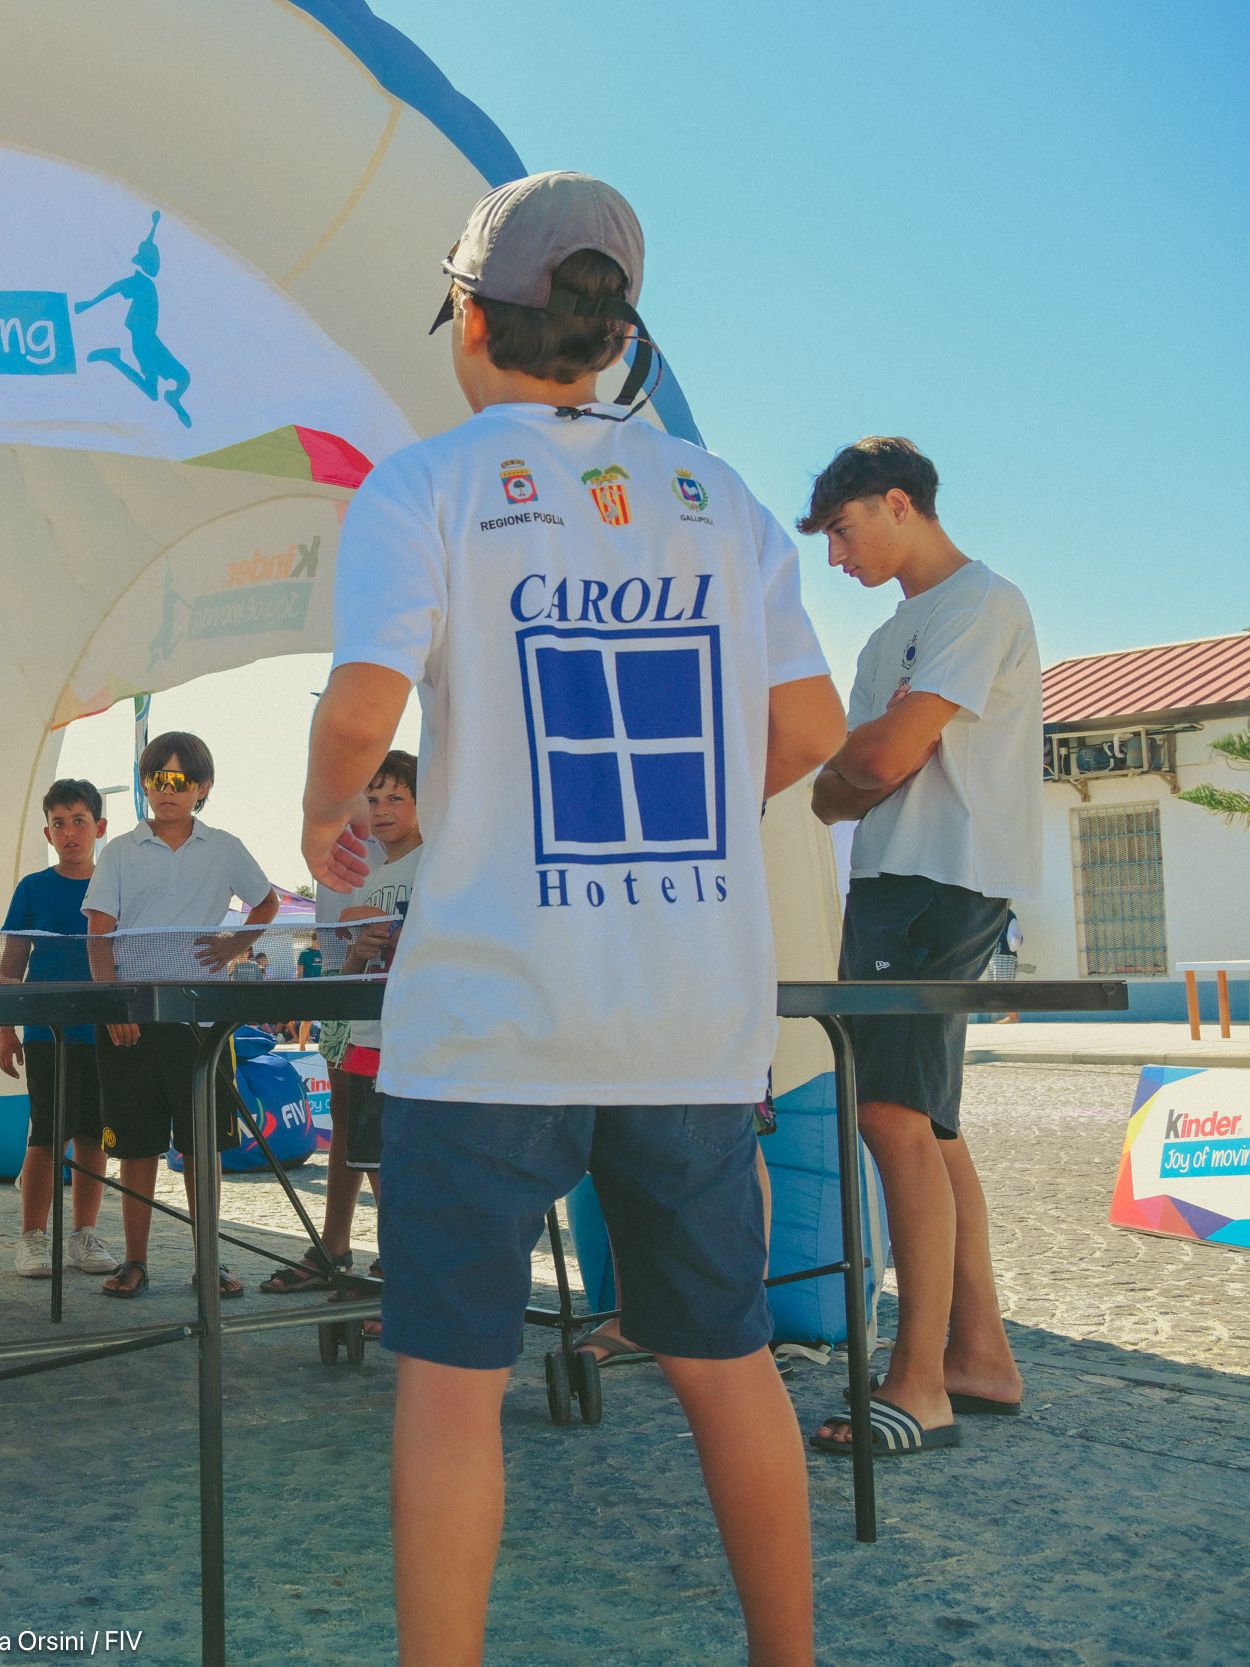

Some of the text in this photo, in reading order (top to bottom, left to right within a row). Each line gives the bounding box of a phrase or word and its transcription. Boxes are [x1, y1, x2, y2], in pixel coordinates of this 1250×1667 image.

[480, 511, 565, 532] REGIONE PUGLIA
[680, 514, 714, 525] GALLIPOLI
[510, 573, 713, 624] CAROLI
[536, 866, 727, 908] Hotels
[281, 1100, 306, 1129] FIV
[309, 1100, 322, 1113] oy
[1165, 1109, 1242, 1139] Kinder
[1165, 1149, 1190, 1173] Joy
[1193, 1146, 1210, 1168] of
